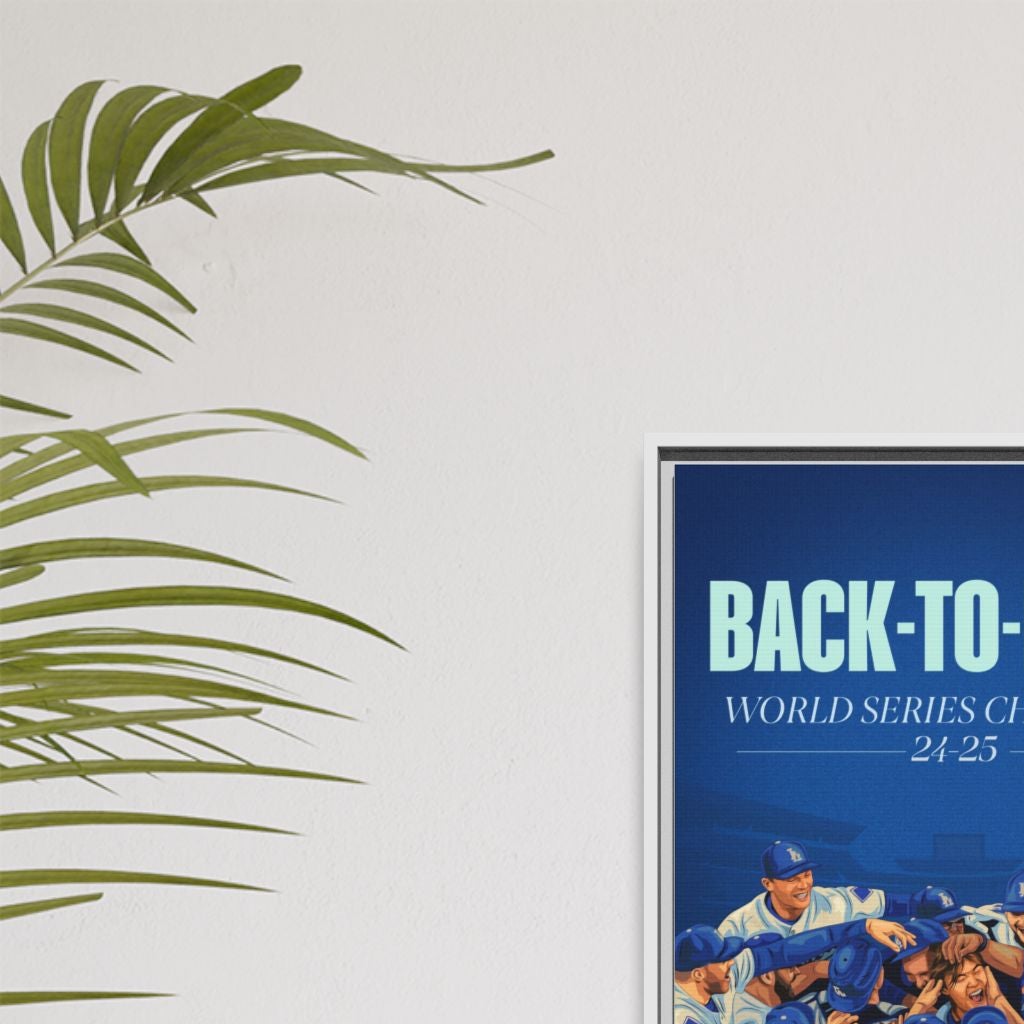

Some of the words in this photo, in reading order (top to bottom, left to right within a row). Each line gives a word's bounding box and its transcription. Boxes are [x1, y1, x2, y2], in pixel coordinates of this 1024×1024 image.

[725, 695, 853, 724] WORLD
[860, 695, 976, 724] SERIES
[910, 735, 998, 763] 24-25
